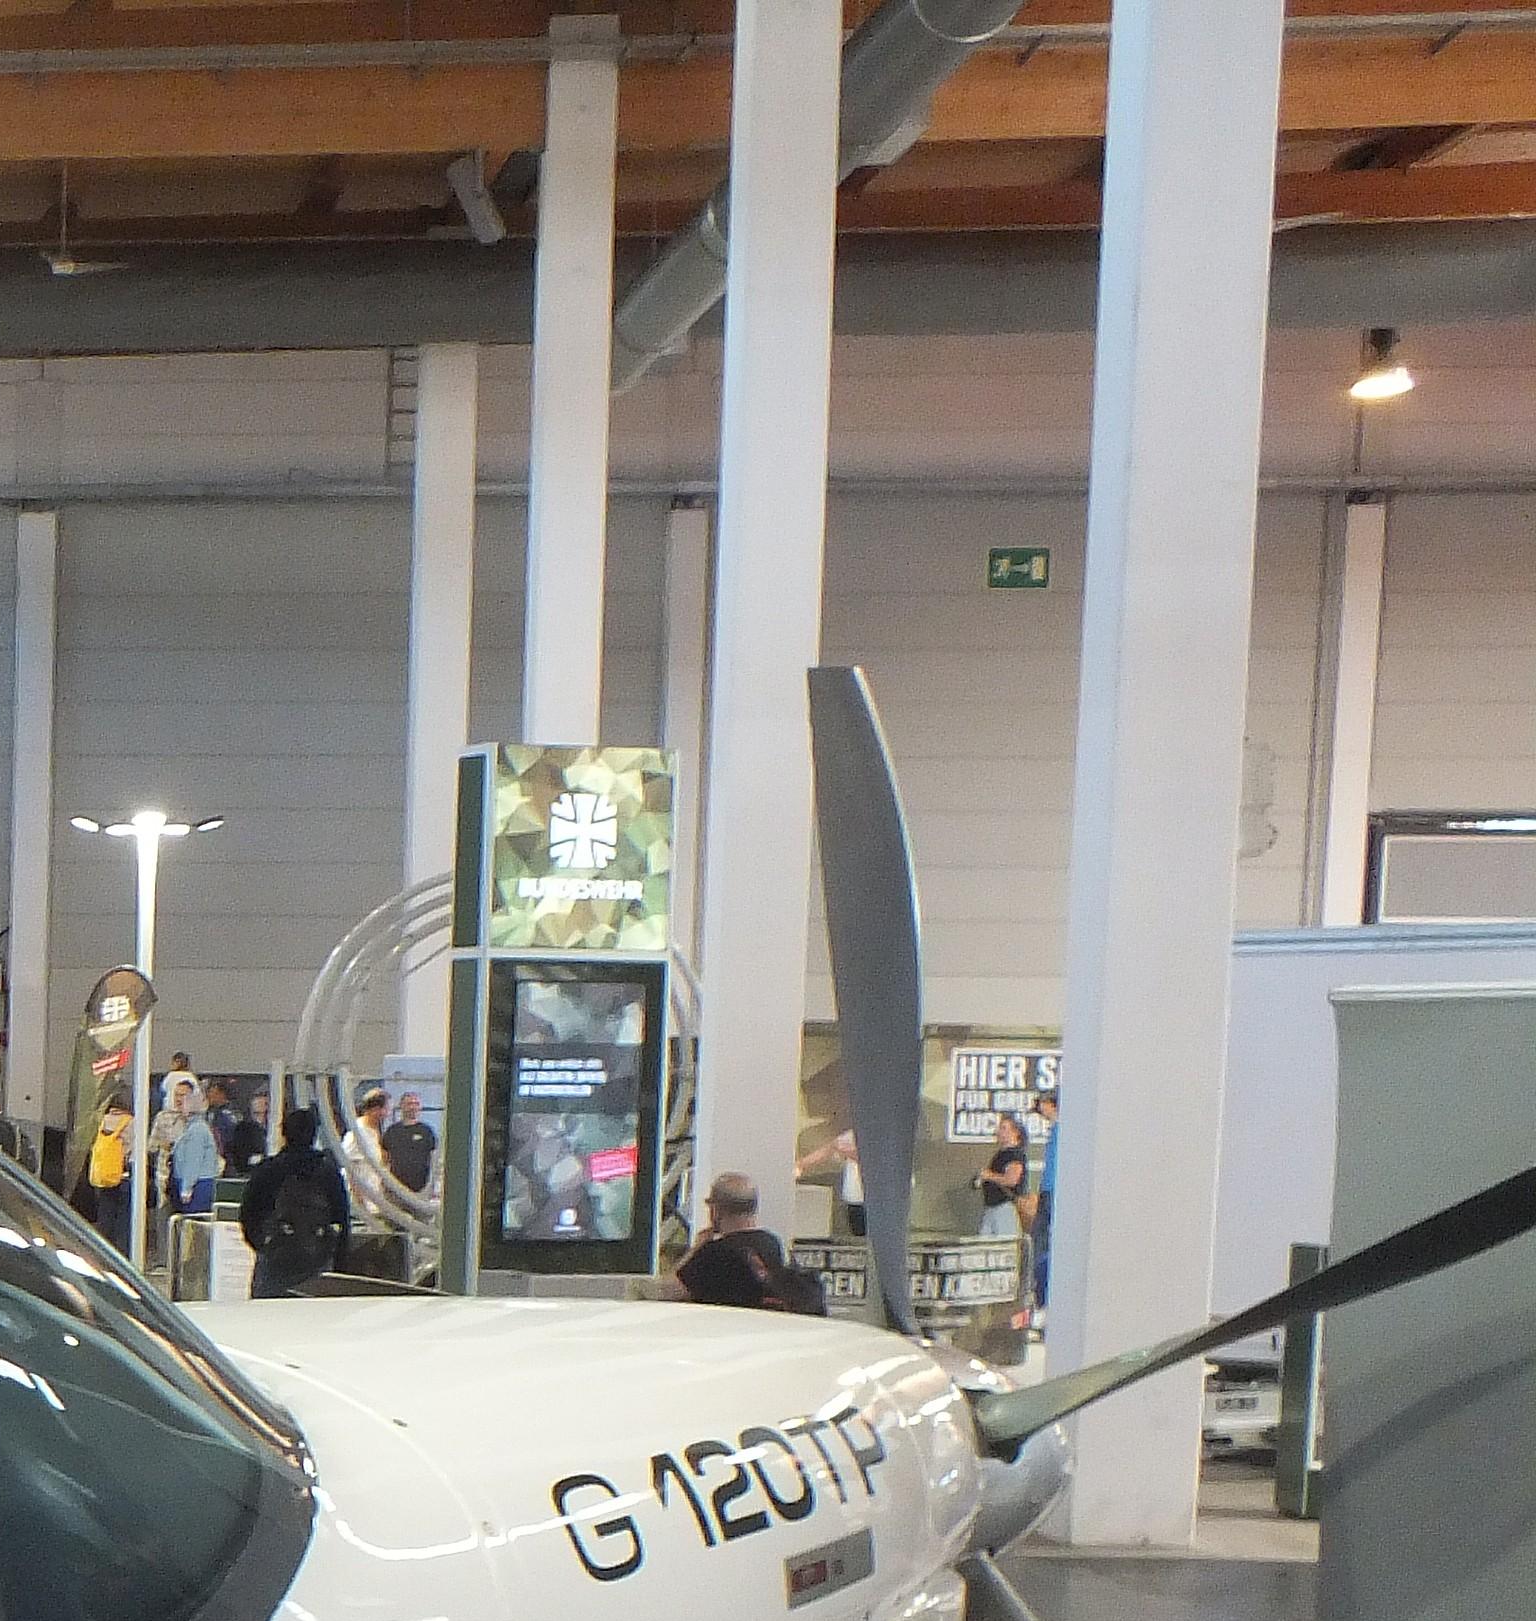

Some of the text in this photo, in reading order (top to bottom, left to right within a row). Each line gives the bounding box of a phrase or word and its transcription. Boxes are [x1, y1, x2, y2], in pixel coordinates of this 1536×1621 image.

[958, 1055, 1062, 1090] HIER S
[550, 1405, 887, 1582] G 120TP
